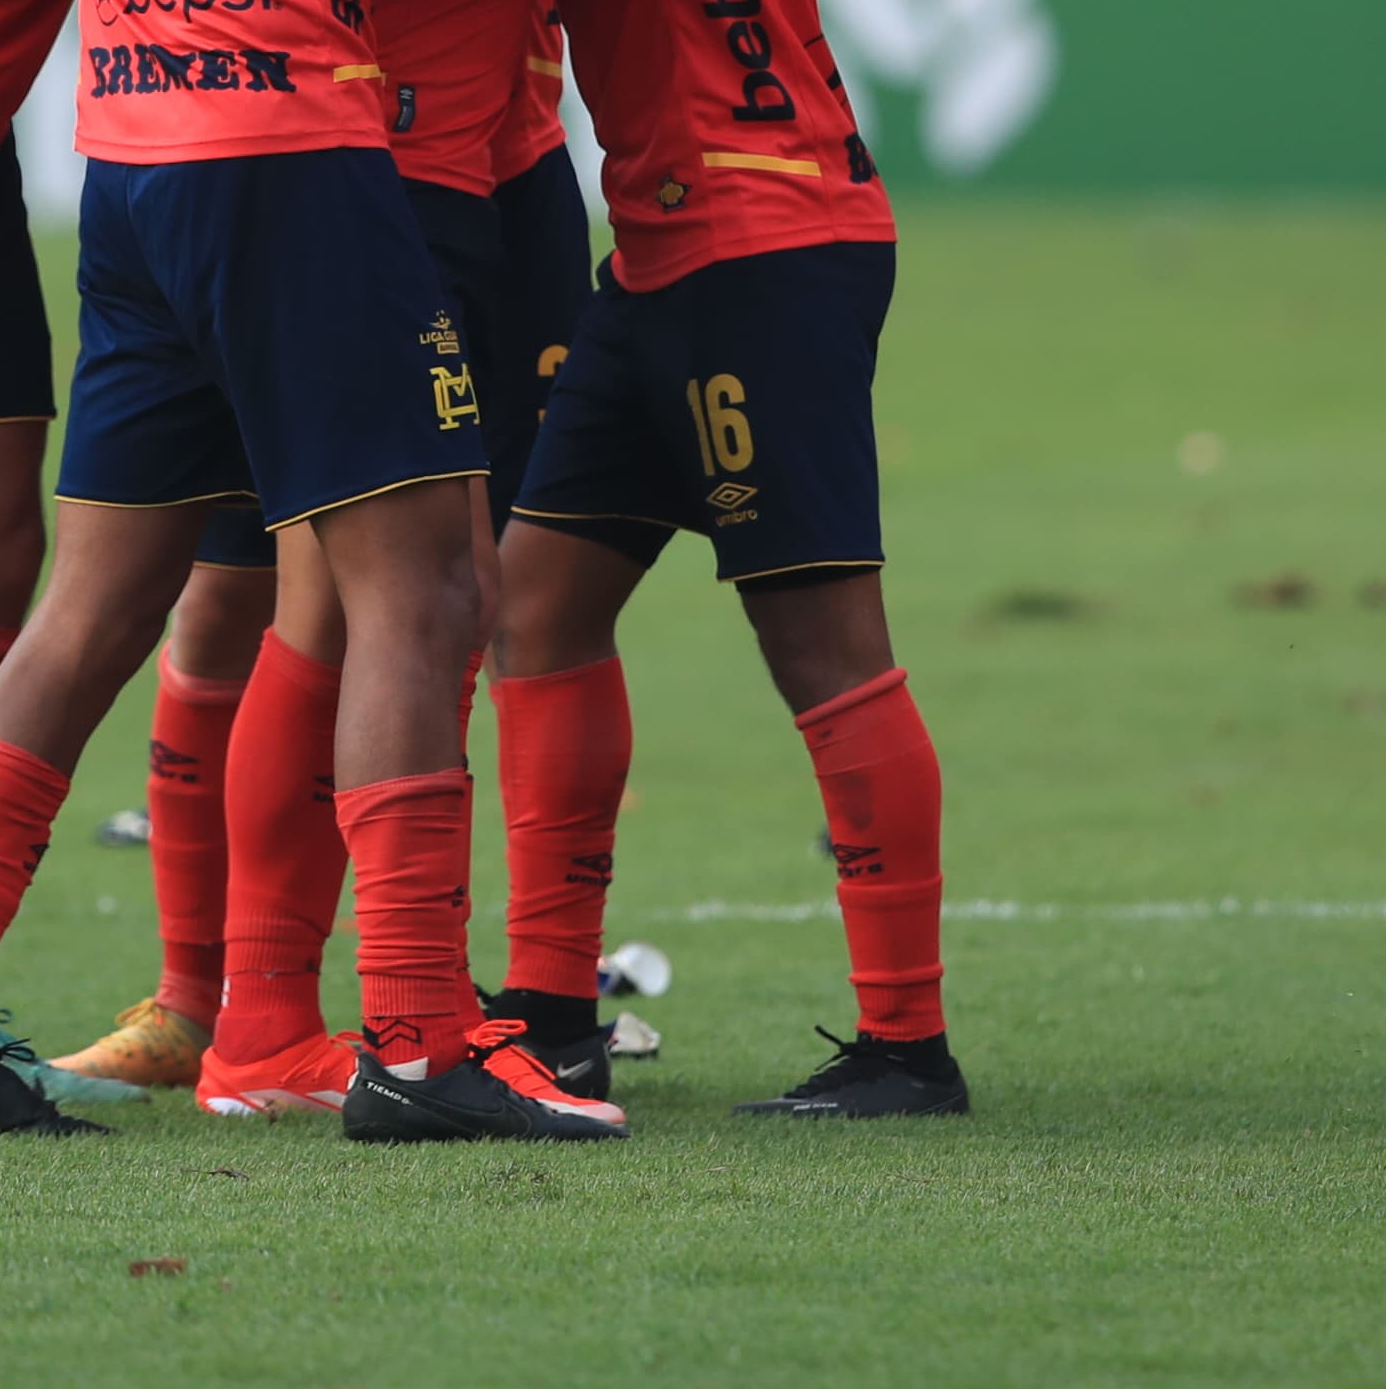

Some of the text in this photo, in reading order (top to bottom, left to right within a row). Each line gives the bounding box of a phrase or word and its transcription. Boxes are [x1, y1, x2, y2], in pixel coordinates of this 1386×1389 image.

[88, 43, 297, 98] BREMEN
[686, 373, 754, 476] 16
[715, 509, 759, 527] umbro
